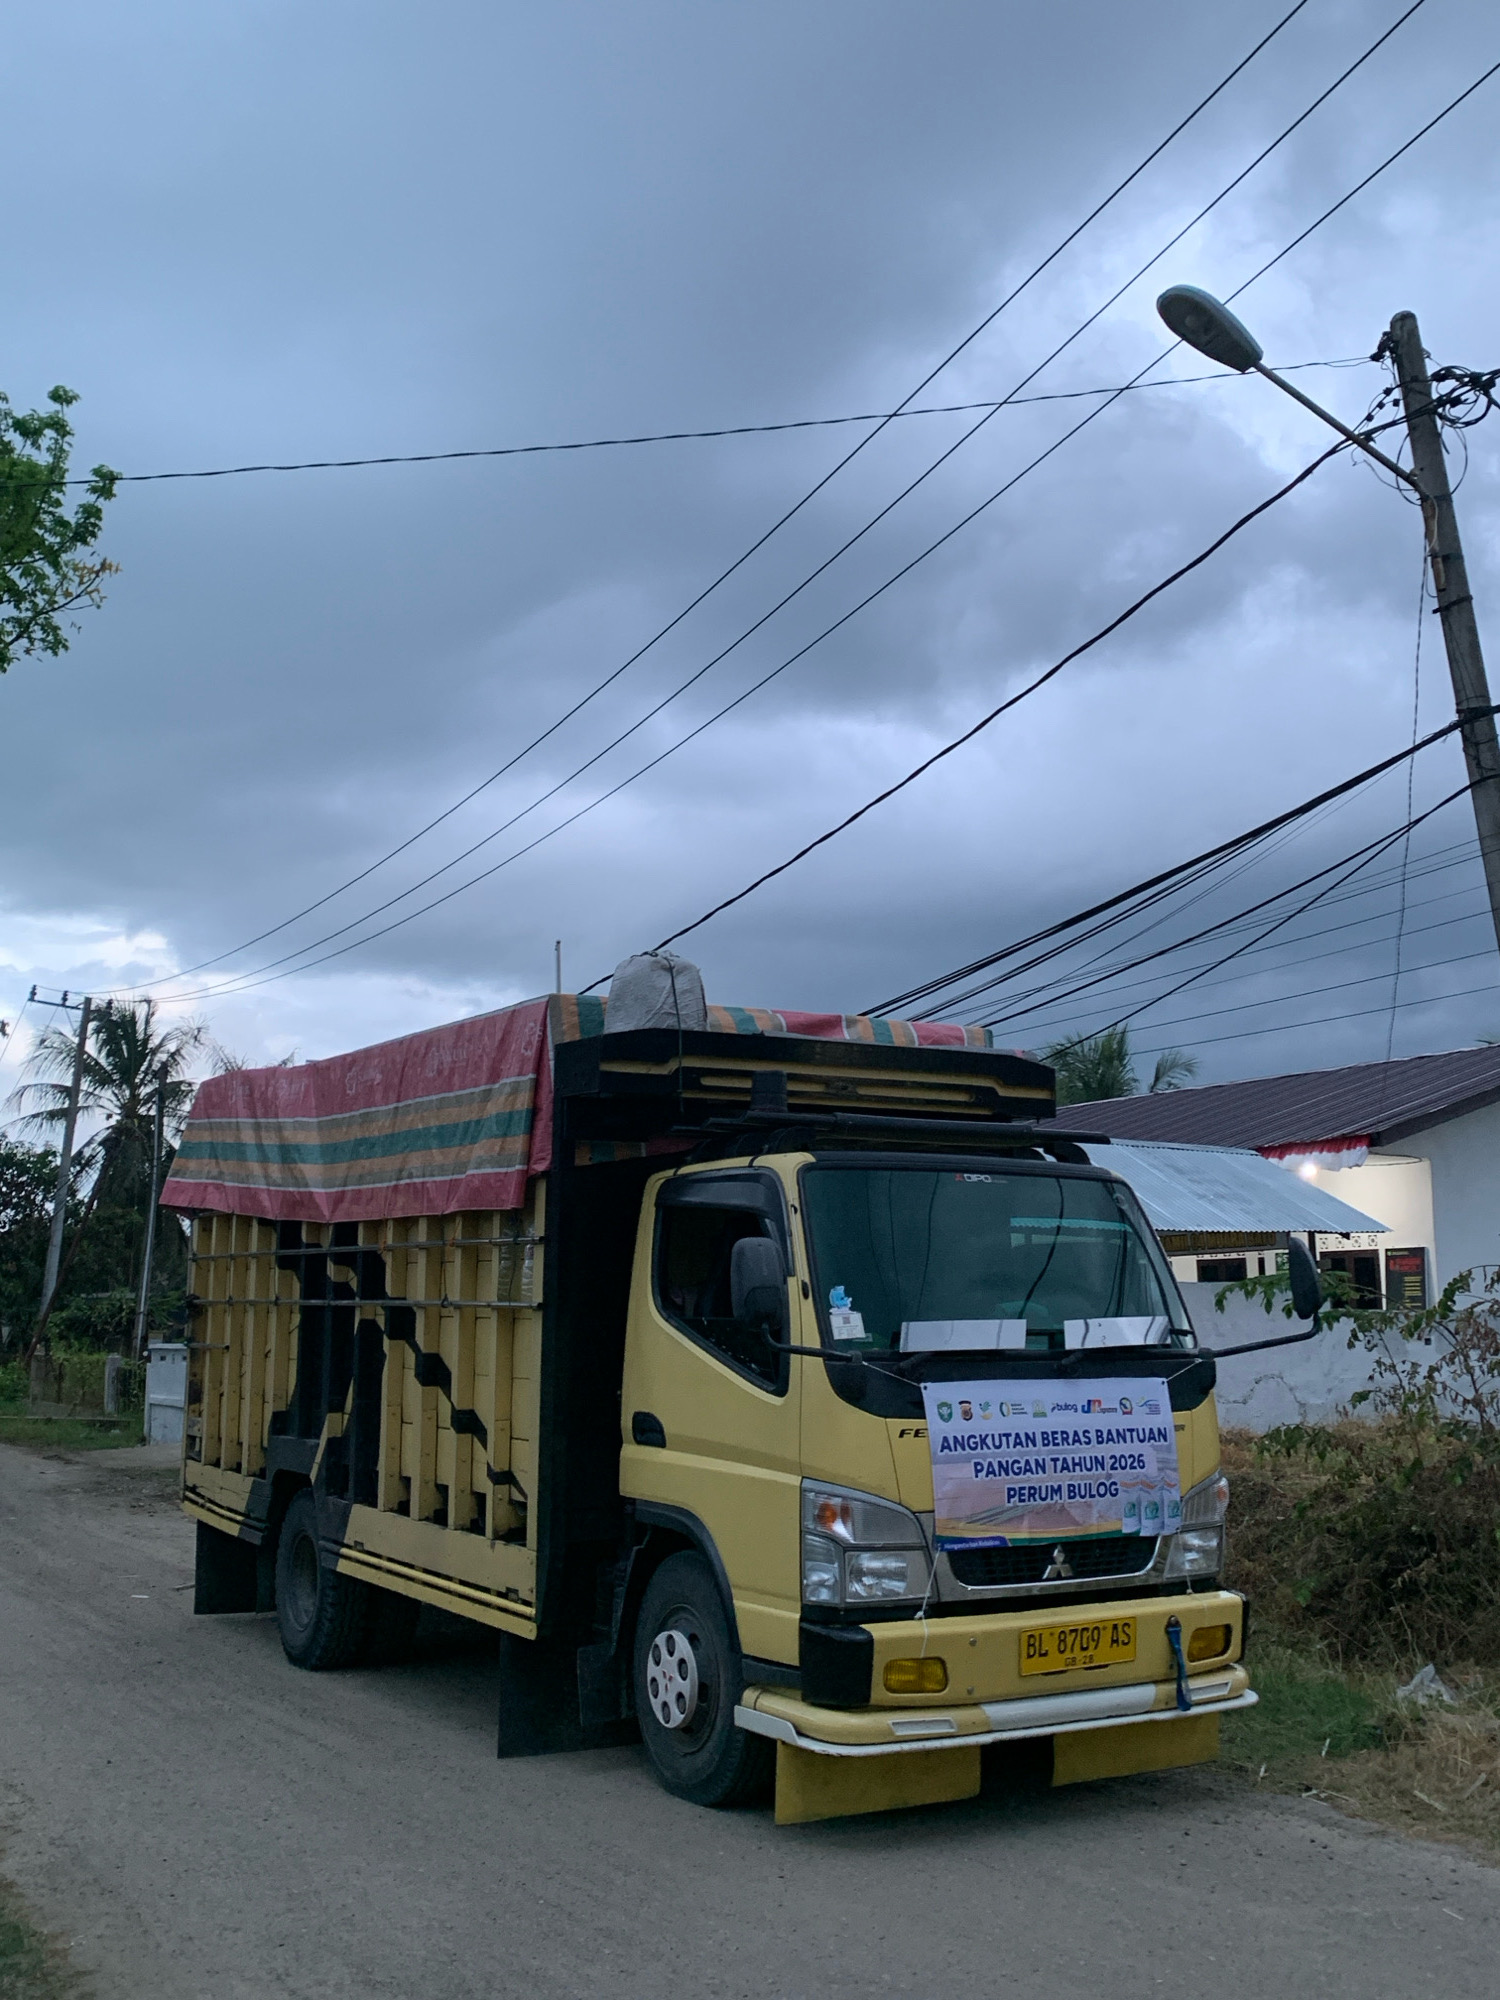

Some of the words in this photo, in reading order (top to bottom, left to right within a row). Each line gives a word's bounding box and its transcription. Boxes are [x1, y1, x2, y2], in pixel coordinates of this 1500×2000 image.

[1056, 1402, 1078, 1413] bulog
[940, 1431, 1038, 1453] ANGKUTAN
[1041, 1429, 1092, 1448] BERAS
[1096, 1427, 1168, 1445] BANTUAN
[973, 1457, 1046, 1478] PANGAN
[1050, 1455, 1106, 1474] TAHUN
[1109, 1453, 1146, 1471] 2026
[1007, 1484, 1063, 1504] PERUM
[1067, 1481, 1119, 1500] BULOG
[1026, 1633, 1049, 1659] BL
[1057, 1625, 1101, 1655] 8709
[1110, 1622, 1132, 1649] AS
